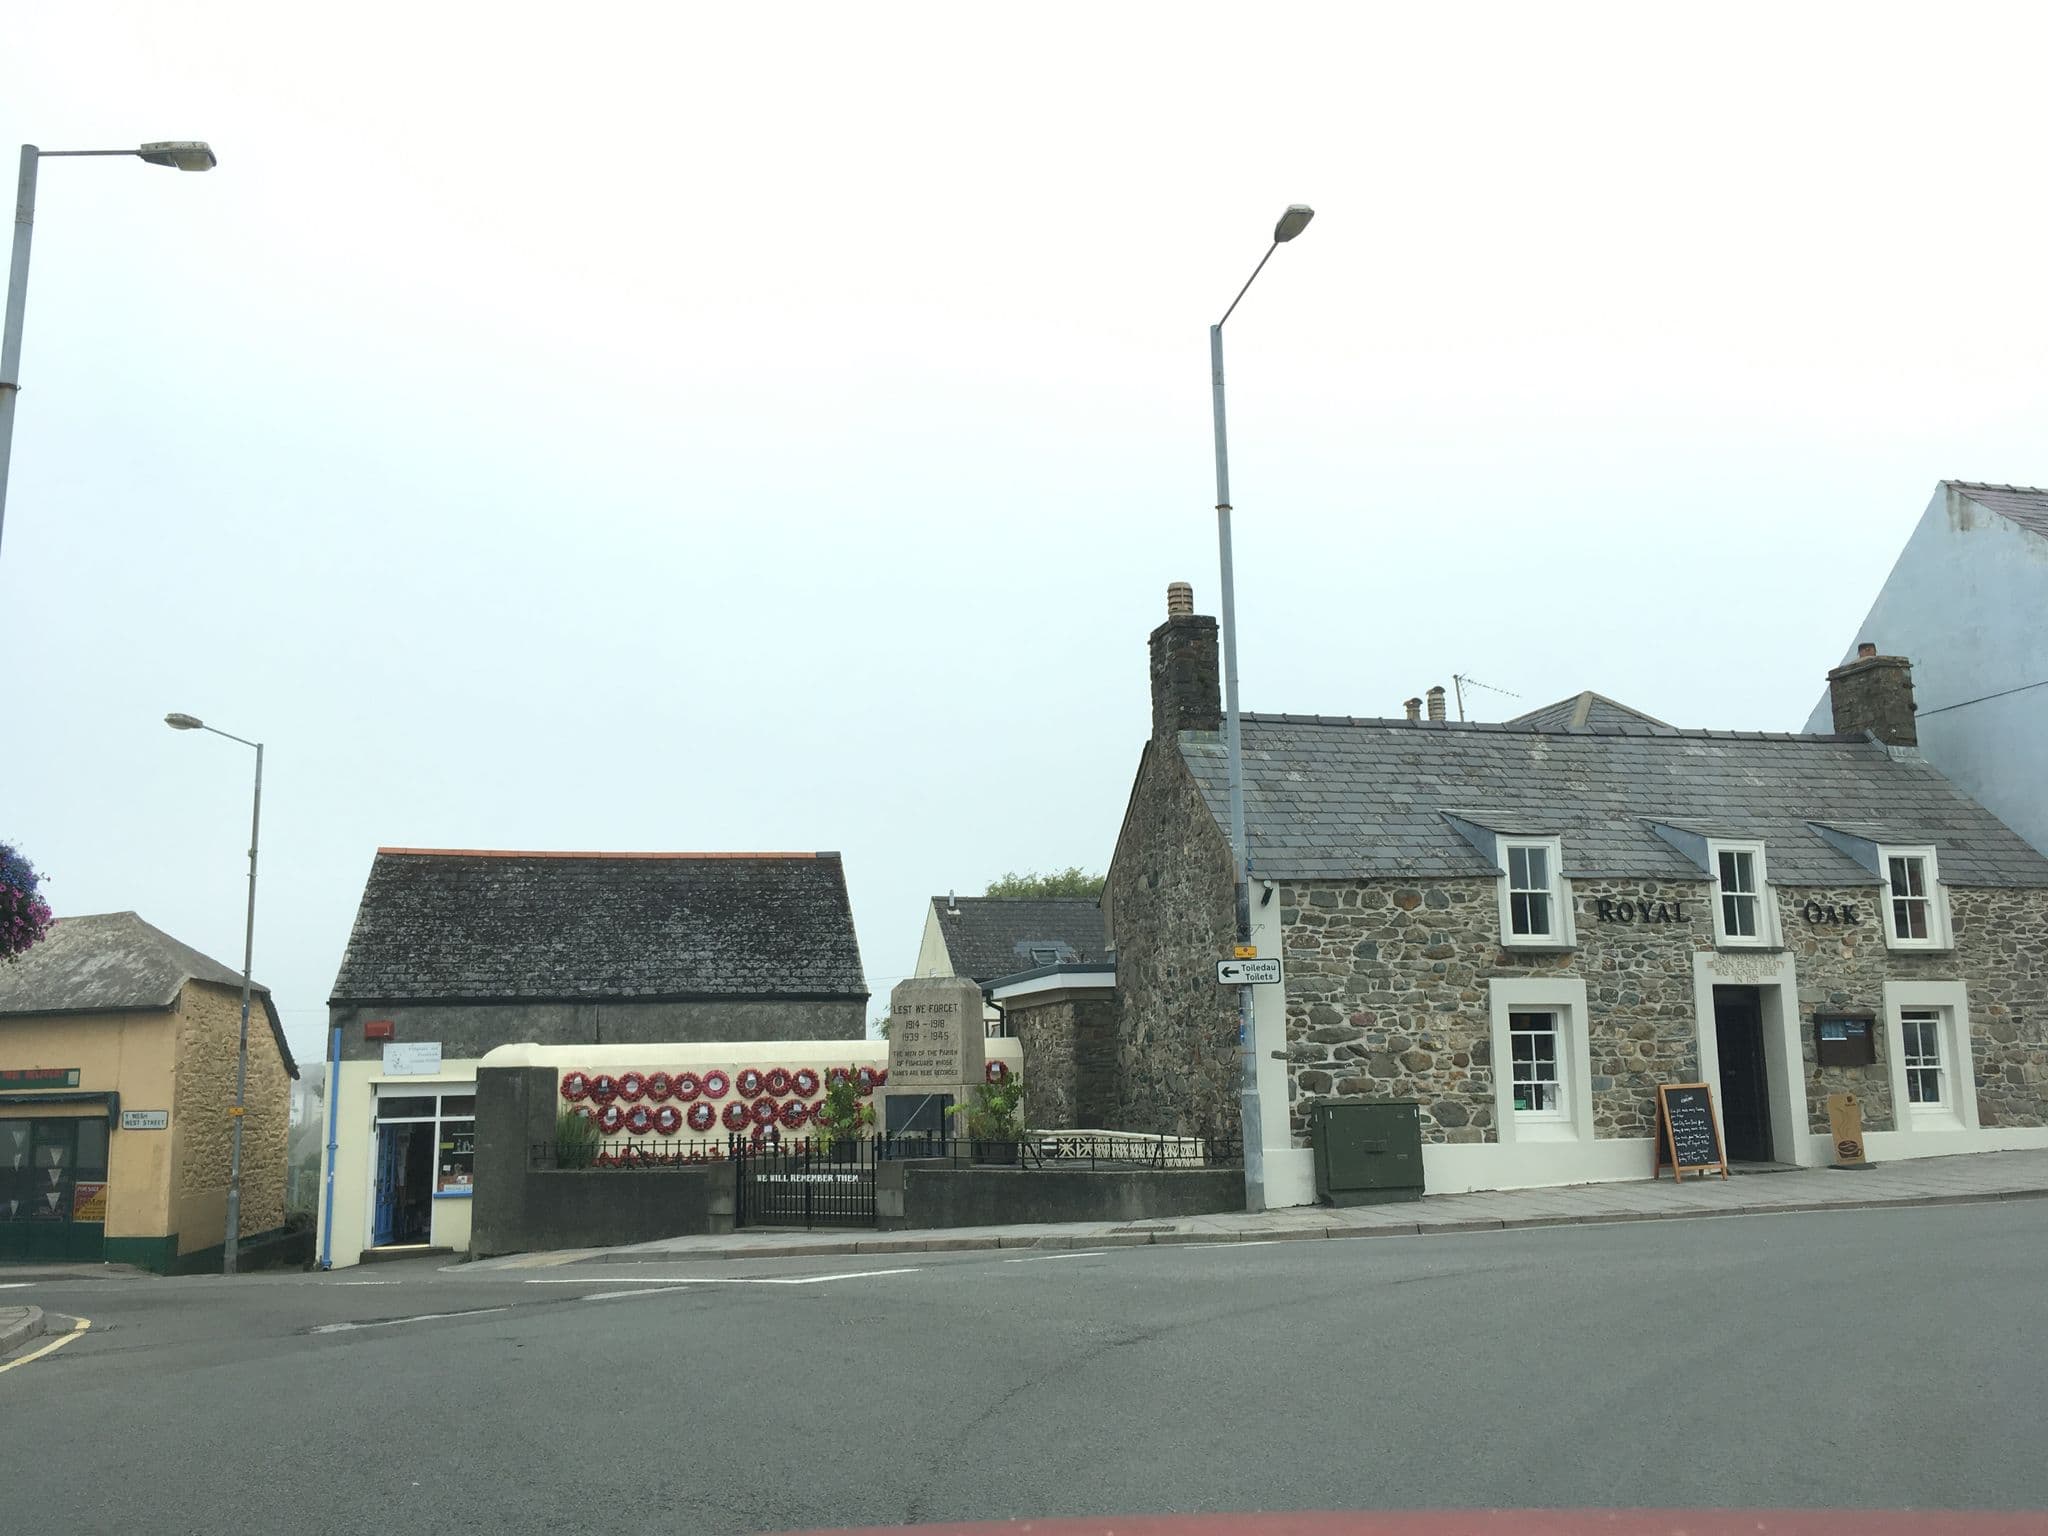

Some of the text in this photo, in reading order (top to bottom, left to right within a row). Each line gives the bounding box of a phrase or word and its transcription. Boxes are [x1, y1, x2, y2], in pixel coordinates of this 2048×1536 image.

[1597, 900, 1860, 925] ROYAL OAK
[1241, 964, 1276, 972] Toiledau
[1245, 973, 1273, 981] Toilets
[893, 1003, 958, 1014] LEST WE FORGET
[905, 1020, 919, 1029] 1914
[930, 1019, 945, 1028] 1918
[902, 1032, 919, 1041] 1939
[930, 1031, 949, 1040] 1945
[893, 1050, 903, 1058] THE
[927, 1049, 938, 1057] THE
[905, 1059, 933, 1067] FISHGUARD
[756, 1173, 859, 1182] WE WILL REMEMBER THEM
